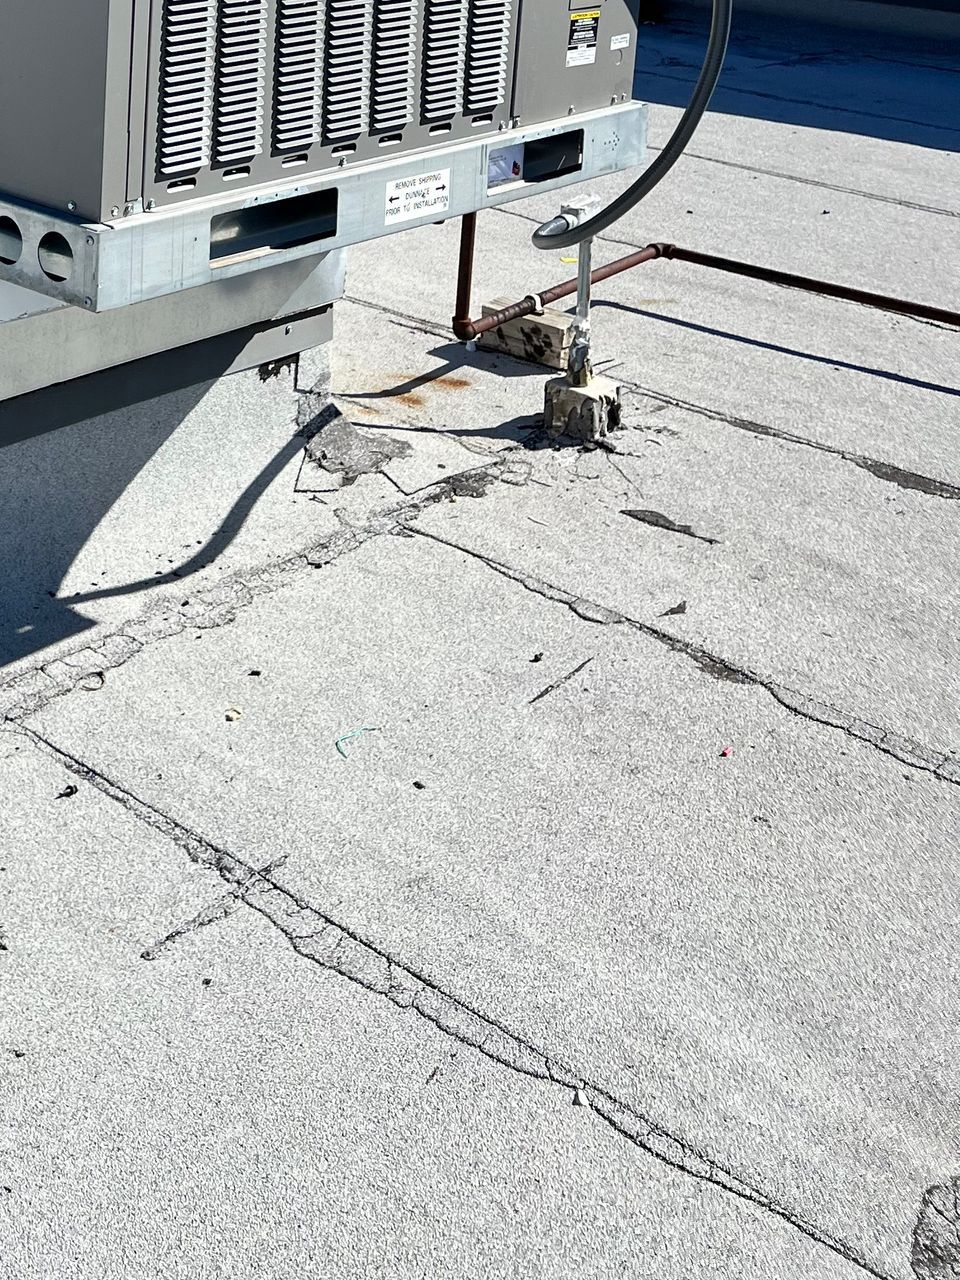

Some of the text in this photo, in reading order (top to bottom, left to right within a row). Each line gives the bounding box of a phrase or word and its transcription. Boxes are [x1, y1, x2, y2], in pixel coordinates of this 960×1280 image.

[394, 173, 442, 190] REMOVE SHIPPING
[385, 206, 401, 216] PRIOR
[403, 203, 411, 212] TO
[413, 195, 449, 210] INSTALLATION
